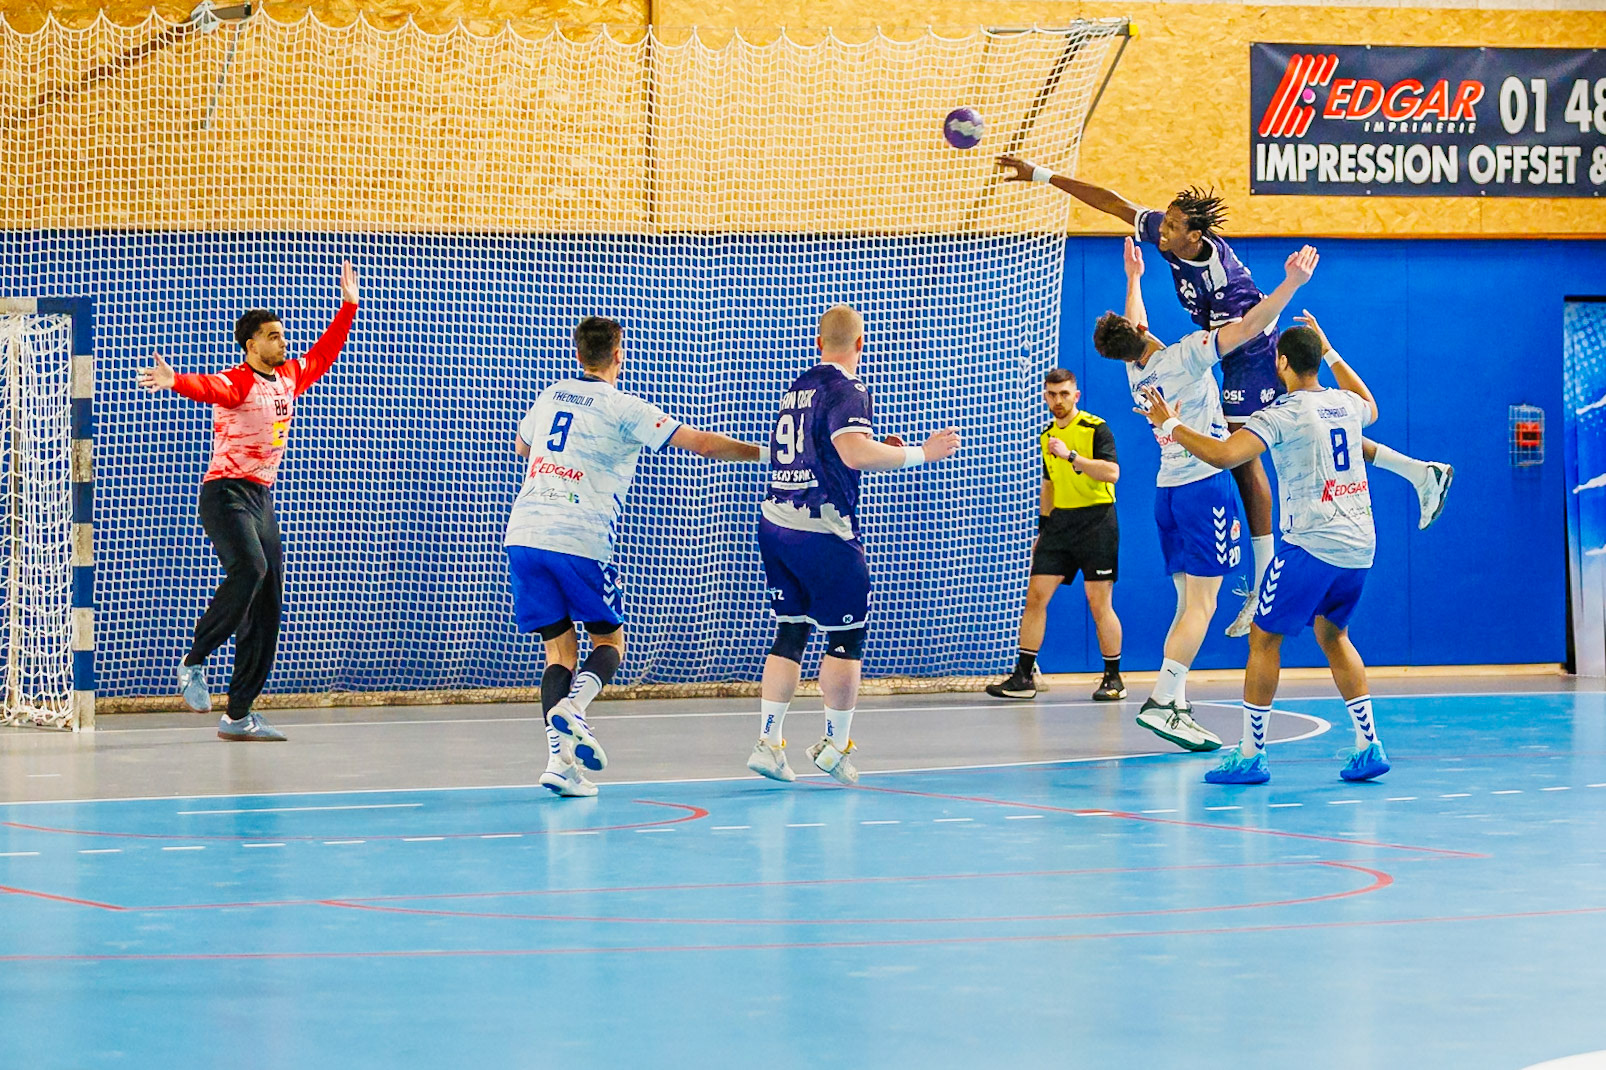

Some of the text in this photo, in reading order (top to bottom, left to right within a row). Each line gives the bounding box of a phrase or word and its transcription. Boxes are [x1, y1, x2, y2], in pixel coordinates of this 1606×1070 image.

[1323, 78, 1485, 121] EDGAR
[1499, 76, 1547, 134] 01
[1364, 121, 1477, 134] IMPRIMERIE
[1256, 143, 1458, 184] IMPRESSION
[1468, 144, 1581, 185] OFFSET
[546, 410, 574, 453] 9
[1330, 427, 1350, 472] 8
[538, 462, 584, 481] EDGAR
[1334, 480, 1367, 497] EDGAR
